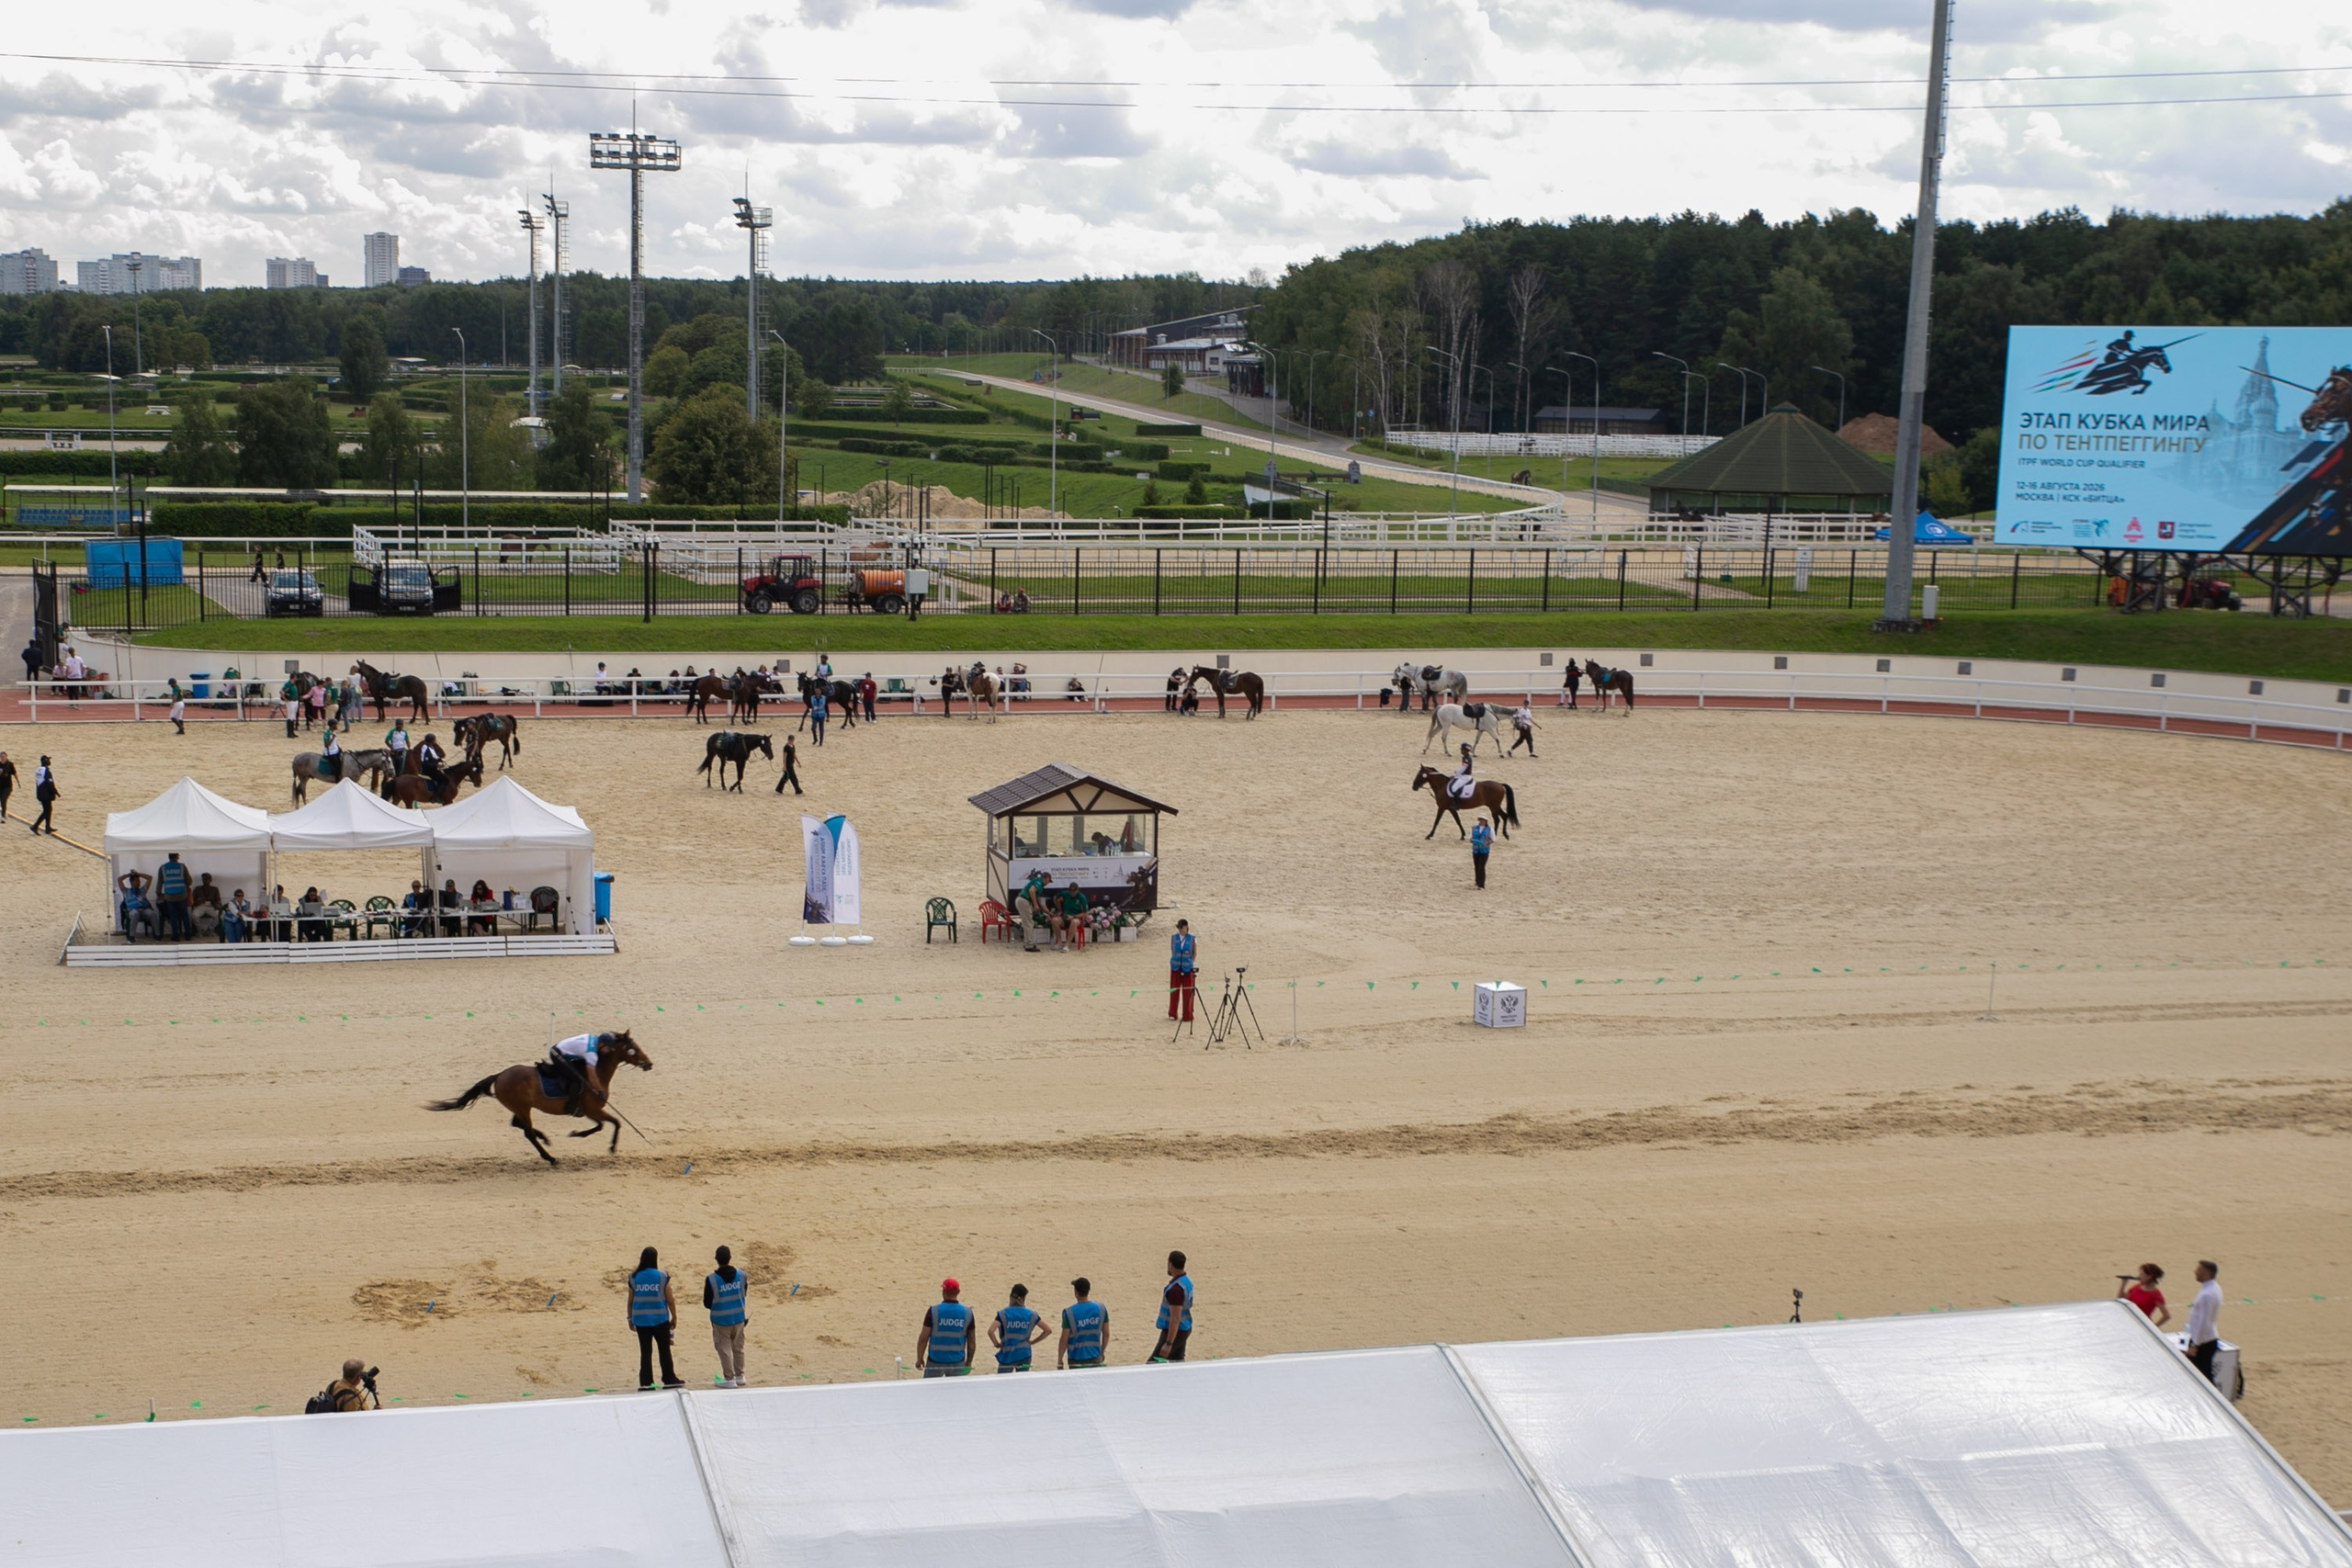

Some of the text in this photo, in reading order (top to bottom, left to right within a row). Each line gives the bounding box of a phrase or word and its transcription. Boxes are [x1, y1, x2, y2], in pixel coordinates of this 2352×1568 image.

[2019, 412, 2211, 432] ЭТАП КУБКА МИРА
[2018, 434, 2207, 453] ПО ТЕНТПЕГГИНГУ
[2018, 457, 2145, 469] ITPF WORLD CUP QUALIFIER
[2040, 482, 2080, 491] АВГУСТА
[2015, 492, 2054, 502] МОСКВА
[2062, 494, 2081, 502] КСК
[635, 1283, 660, 1292] JUDGE
[719, 1281, 741, 1292] JUDGE
[938, 1317, 965, 1327] JUDGE
[1077, 1316, 1100, 1327] JUDGE
